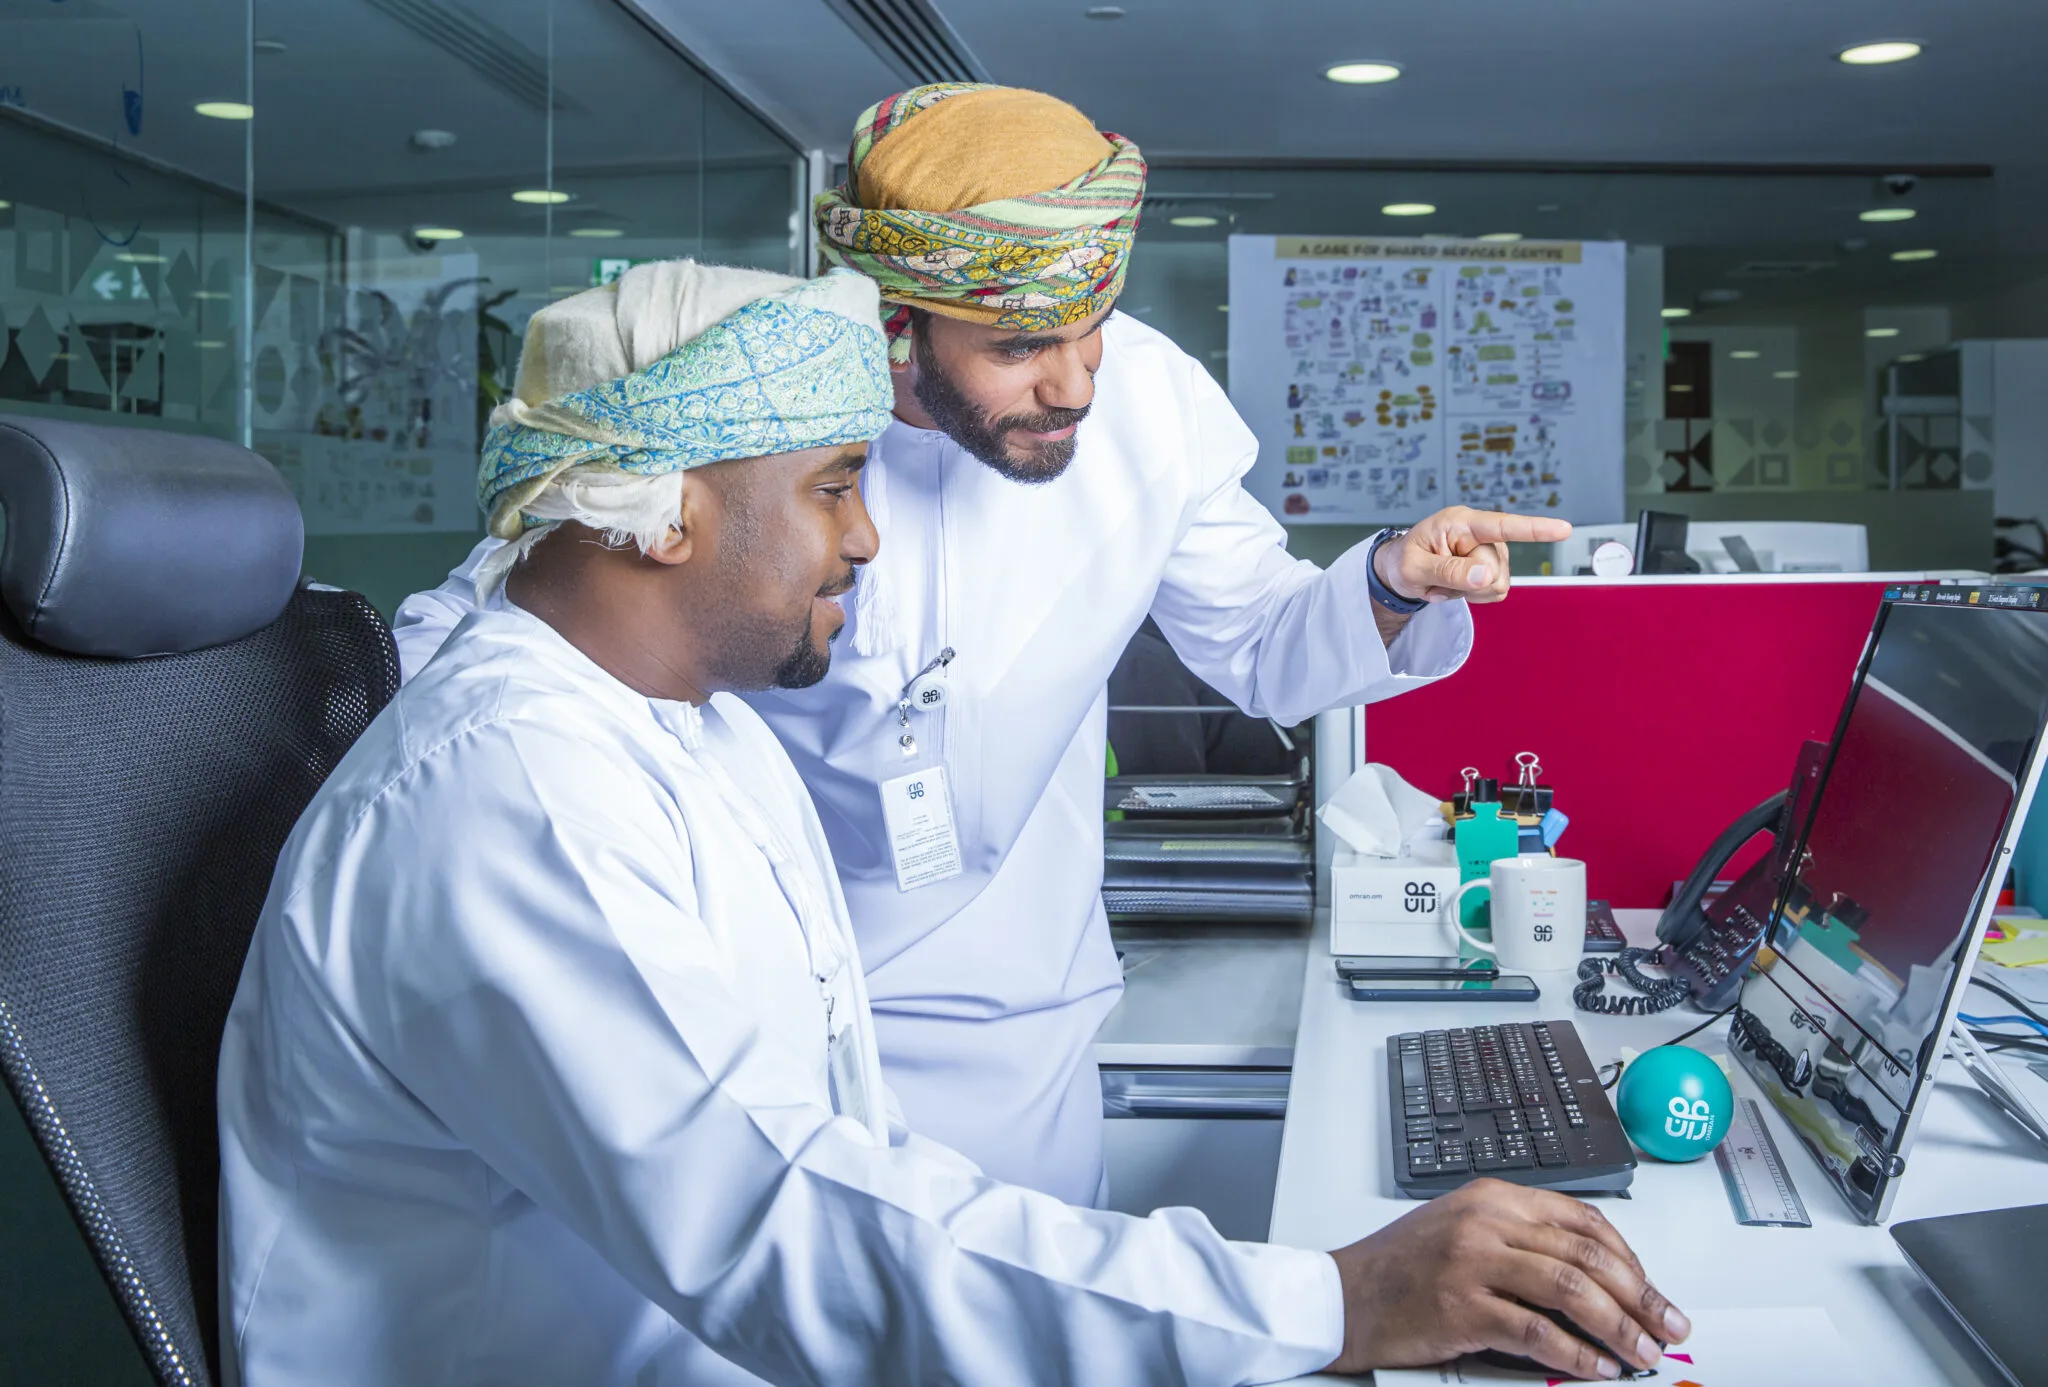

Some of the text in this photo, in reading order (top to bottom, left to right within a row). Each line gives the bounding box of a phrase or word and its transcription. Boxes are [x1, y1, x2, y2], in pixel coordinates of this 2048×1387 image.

[1299, 244, 1309, 255] A
[1312, 244, 1350, 256] CASE
[1353, 244, 1381, 256] FOR
[1384, 245, 1438, 258] SHARED
[1441, 245, 1507, 258] SERVICES
[1704, 1114, 1716, 1141] OMRAN
